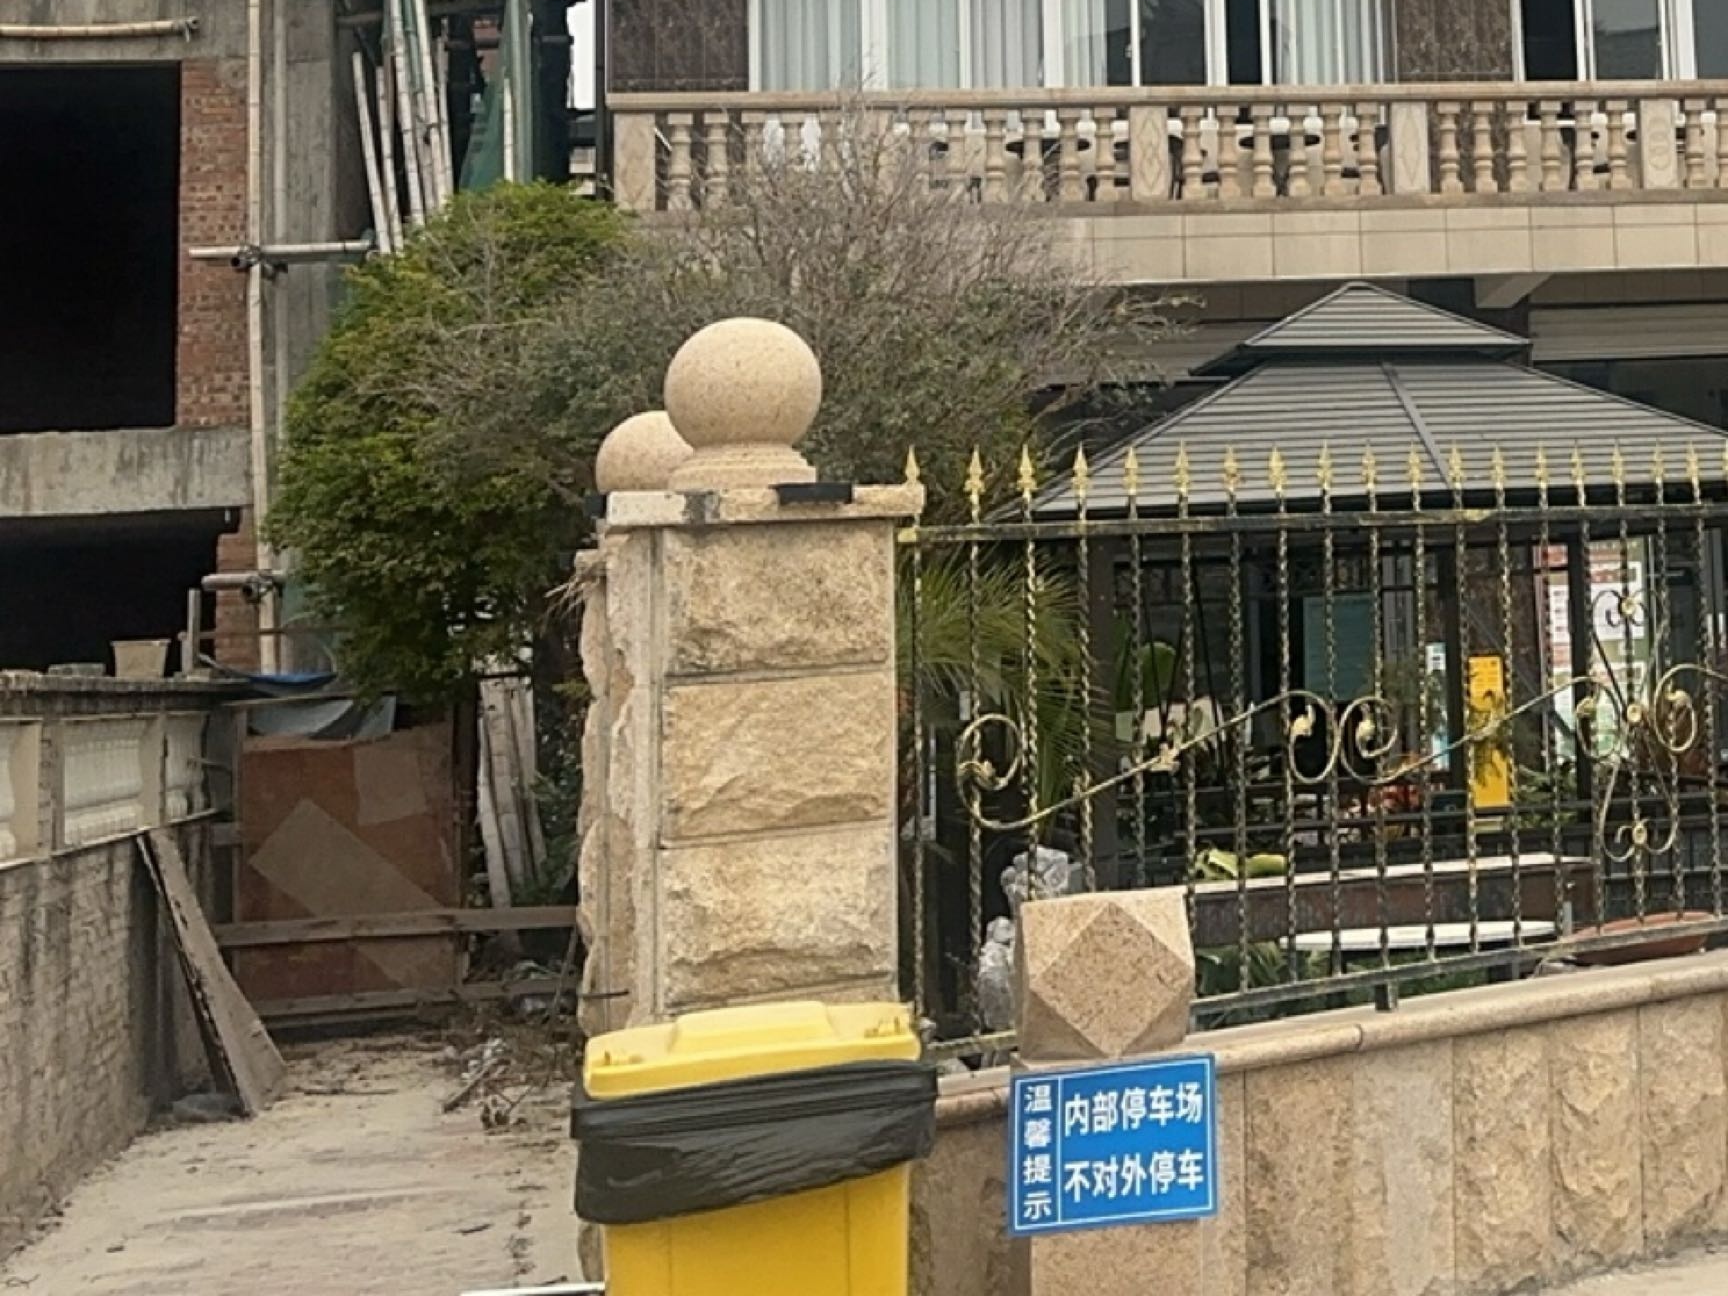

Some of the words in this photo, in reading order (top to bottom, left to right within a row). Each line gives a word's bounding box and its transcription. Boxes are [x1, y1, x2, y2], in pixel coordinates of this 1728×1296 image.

[1064, 1081, 1204, 1137] 内部停车场
[1023, 1084, 1052, 1221] 温馨提示
[1064, 1147, 1204, 1204] 不对外停车
